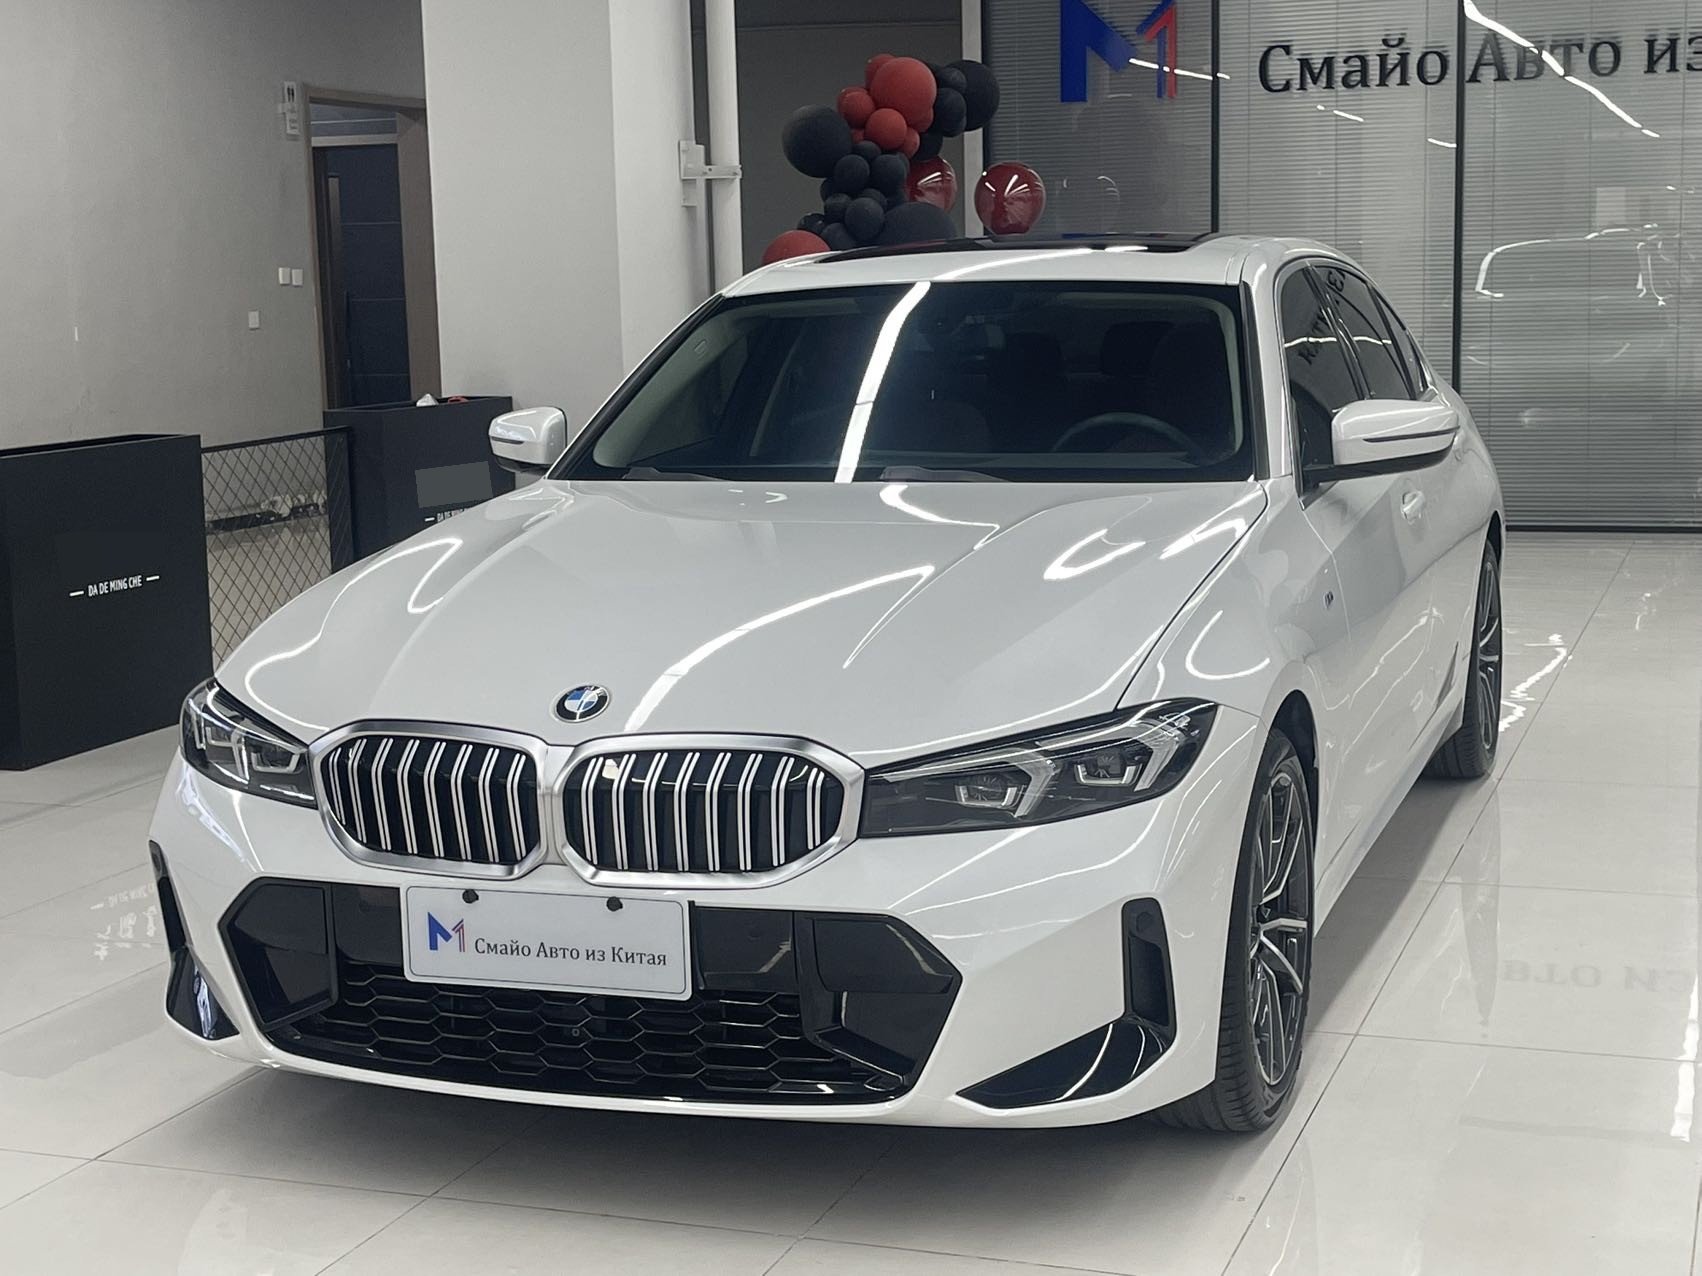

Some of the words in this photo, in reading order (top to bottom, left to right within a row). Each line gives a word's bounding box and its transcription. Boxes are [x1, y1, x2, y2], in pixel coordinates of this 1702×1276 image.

[1258, 36, 1448, 93] Смайо
[1465, 29, 1621, 84] Авто
[88, 584, 98, 597] DA
[99, 582, 108, 594] DE
[109, 578, 127, 591] MING
[128, 575, 142, 588] CHE
[474, 938, 531, 957] Смайо
[536, 942, 580, 960] Авто
[585, 949, 606, 962] из
[611, 945, 667, 966] Китая
